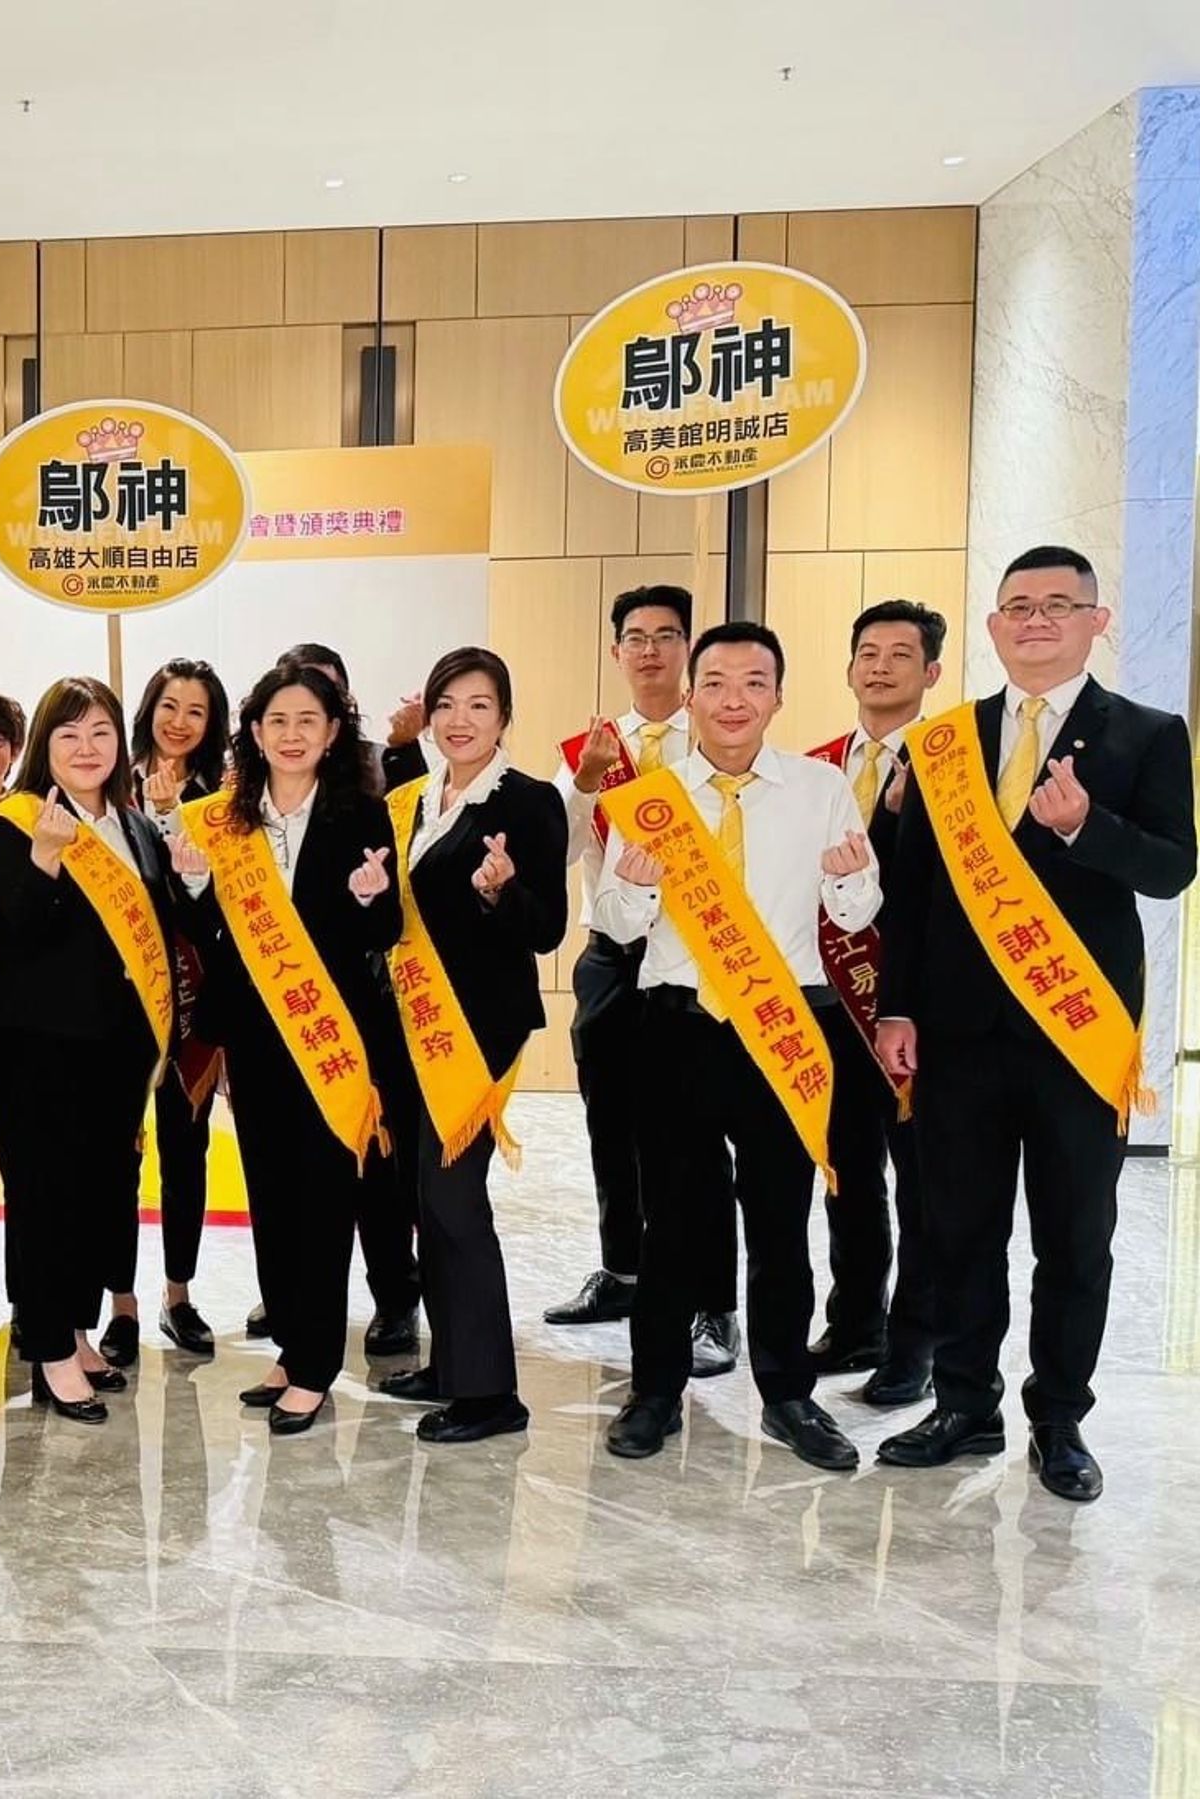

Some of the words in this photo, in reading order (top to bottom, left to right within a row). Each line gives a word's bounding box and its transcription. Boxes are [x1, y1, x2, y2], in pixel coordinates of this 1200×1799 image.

[621, 319, 791, 411] 鄔神
[623, 412, 789, 455] 高美館明誠店
[39, 459, 187, 532] 鄔神
[29, 546, 198, 570] 高雄大順自由店
